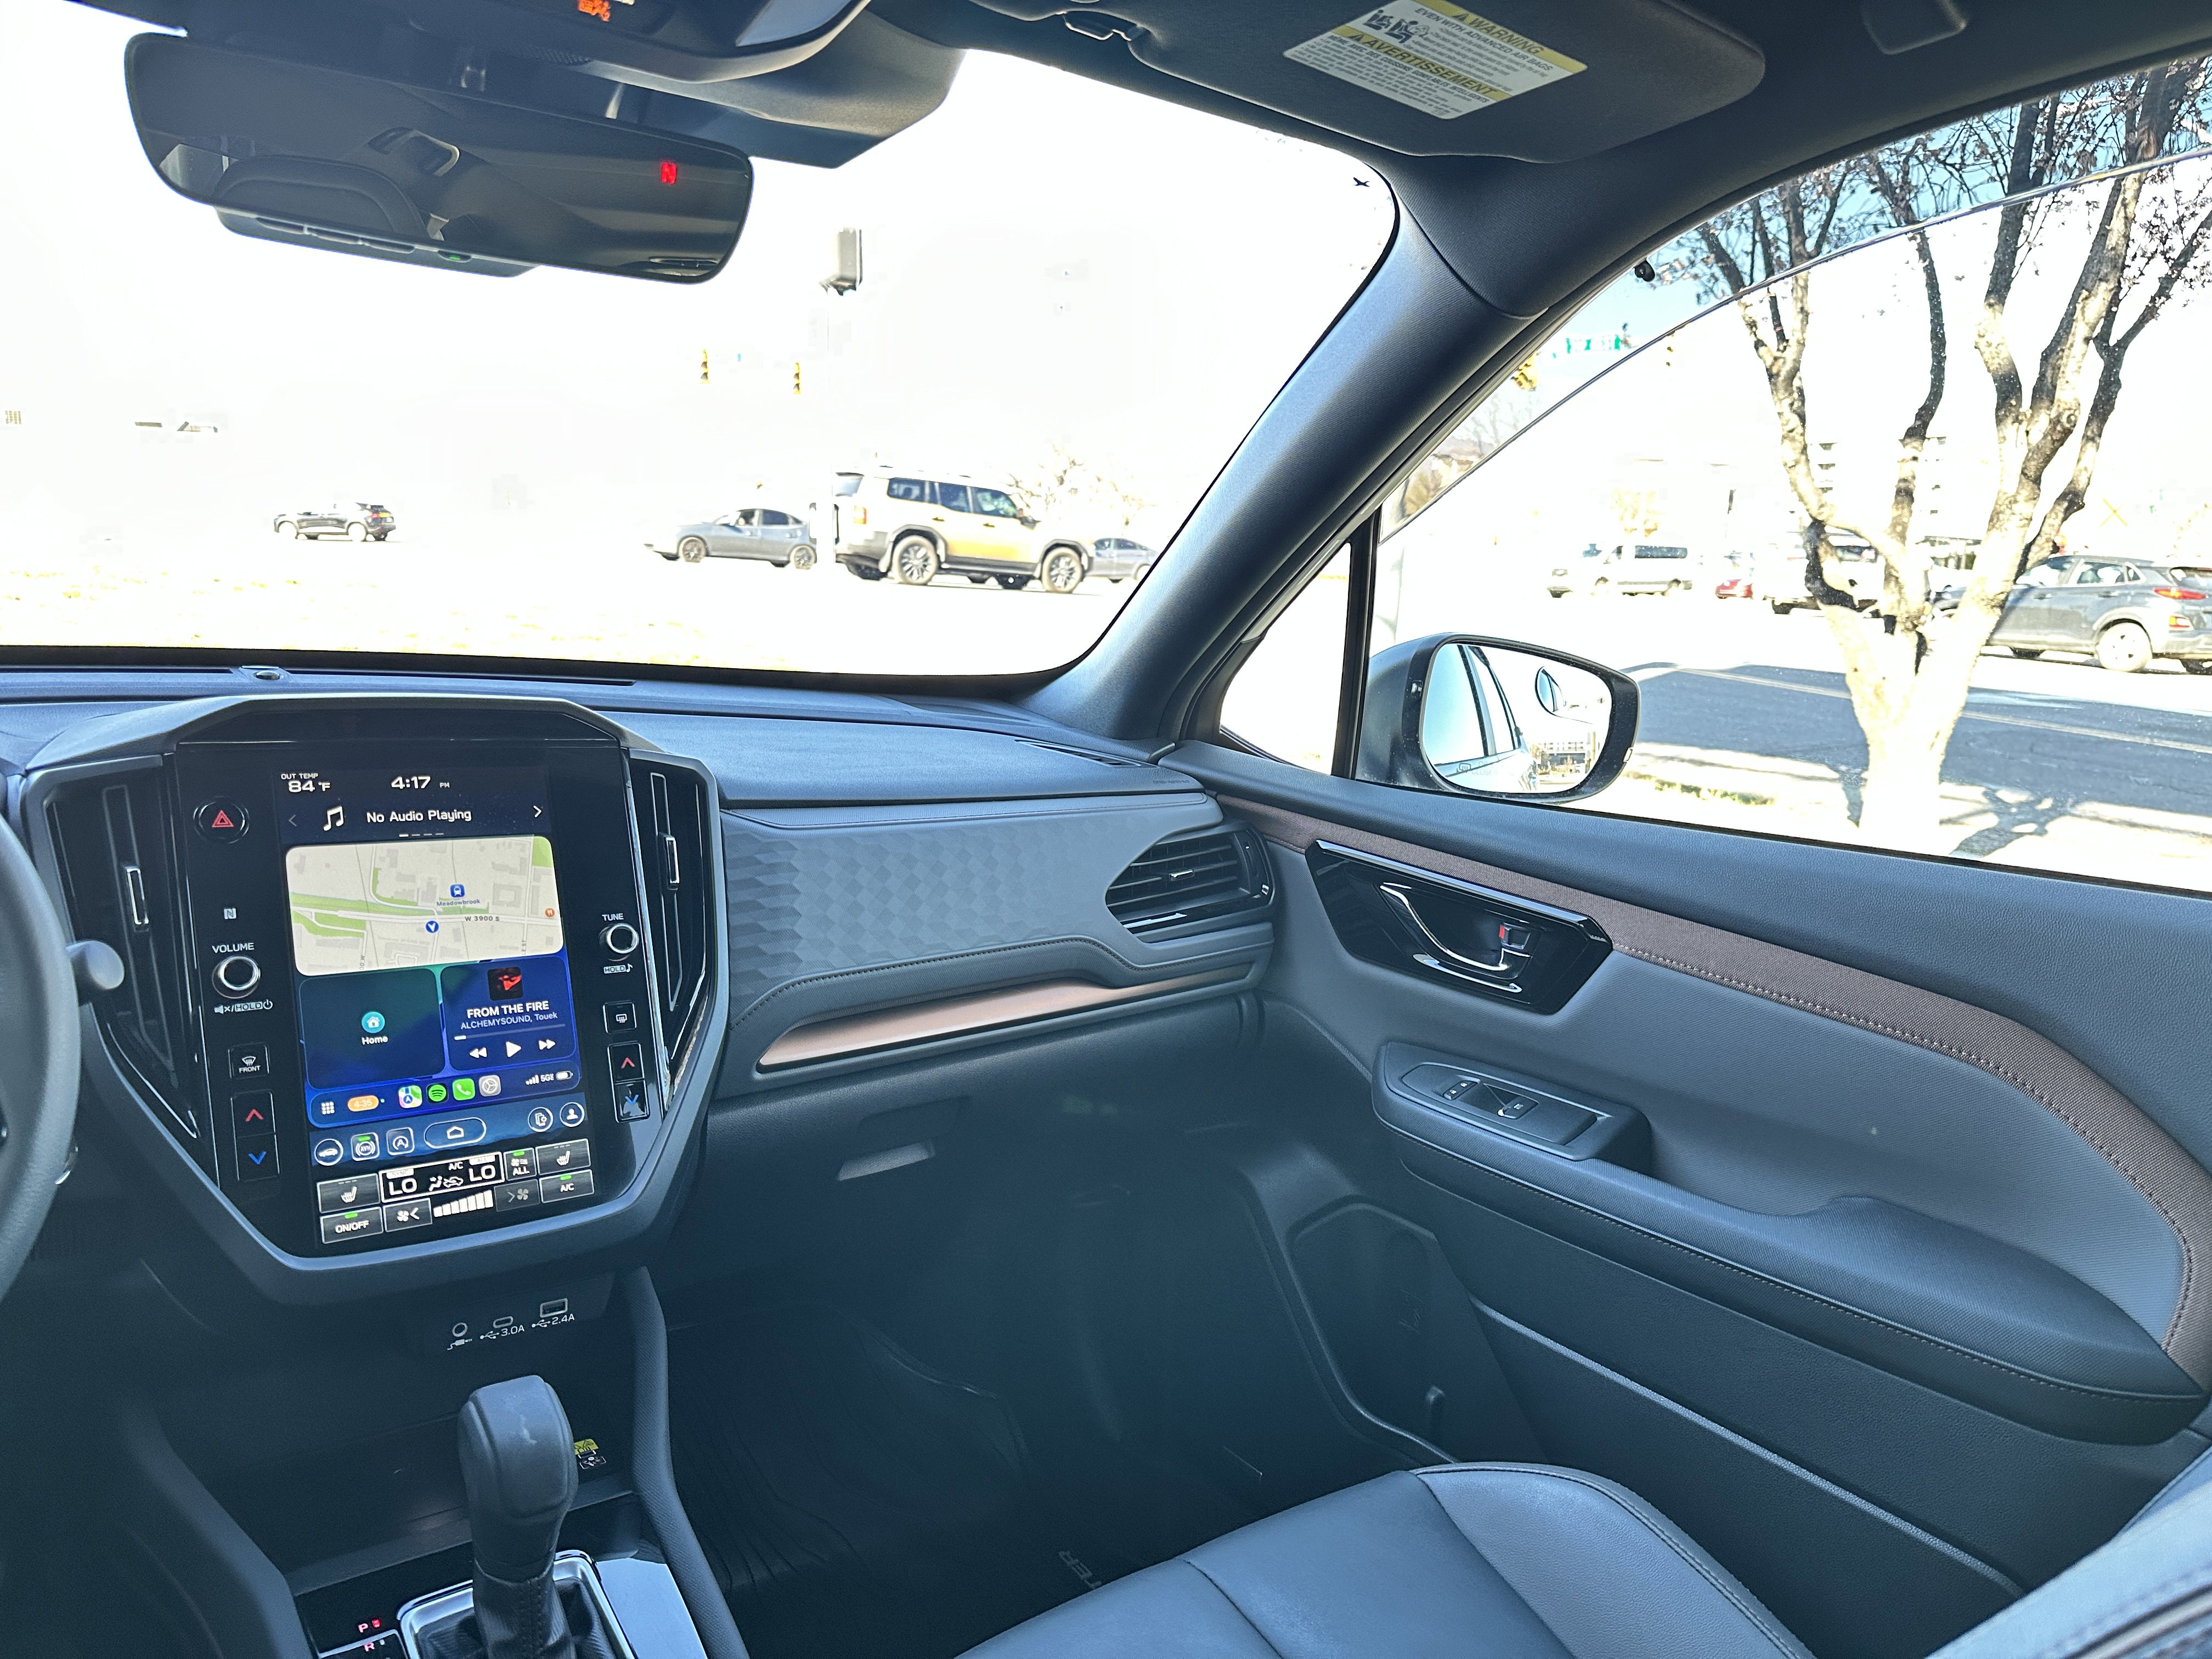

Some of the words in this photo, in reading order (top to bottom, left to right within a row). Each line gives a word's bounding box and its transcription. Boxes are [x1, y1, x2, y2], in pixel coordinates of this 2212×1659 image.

[1414, 7, 1444, 22] EVEN
[1440, 19, 1467, 32] WITH
[1463, 31, 1514, 53] ADVANCED
[1510, 52, 1529, 60] AIR
[1526, 58, 1554, 71] BAGS
[1469, 17, 1544, 55] WARNING
[1347, 43, 1368, 53] AVEC
[1365, 50, 1381, 59] DES
[1362, 40, 1498, 94] AVERTISSEMENT
[288, 780, 315, 793] 84
[391, 775, 431, 789] 4:17
[366, 811, 385, 823] No
[390, 810, 424, 822] Audio
[428, 808, 472, 823] Playing
[436, 898, 481, 906] Meadowbrook
[602, 913, 624, 921] TUNE
[212, 943, 255, 953] VOLUME
[604, 965, 626, 974] HOLD
[467, 1006, 499, 1019] FROM
[501, 1003, 524, 1014] THE
[526, 1000, 549, 1012] FIRE
[460, 1014, 532, 1030] ALCHEMYSOUND,
[534, 1012, 558, 1022] Touek
[362, 1035, 388, 1045] Home
[239, 1065, 261, 1073] FRONT
[354, 1098, 373, 1108] 4:35
[448, 1161, 464, 1171] A/C
[512, 1166, 530, 1176] ALL
[469, 1165, 496, 1182] LO
[389, 1178, 417, 1195] LO
[560, 1183, 574, 1192] A/C
[335, 1220, 369, 1233] ON/OFF
[552, 1313, 575, 1325] 2.4A
[501, 1324, 525, 1337] 3.0A
[358, 1623, 368, 1633] P
[364, 1642, 375, 1652] R
